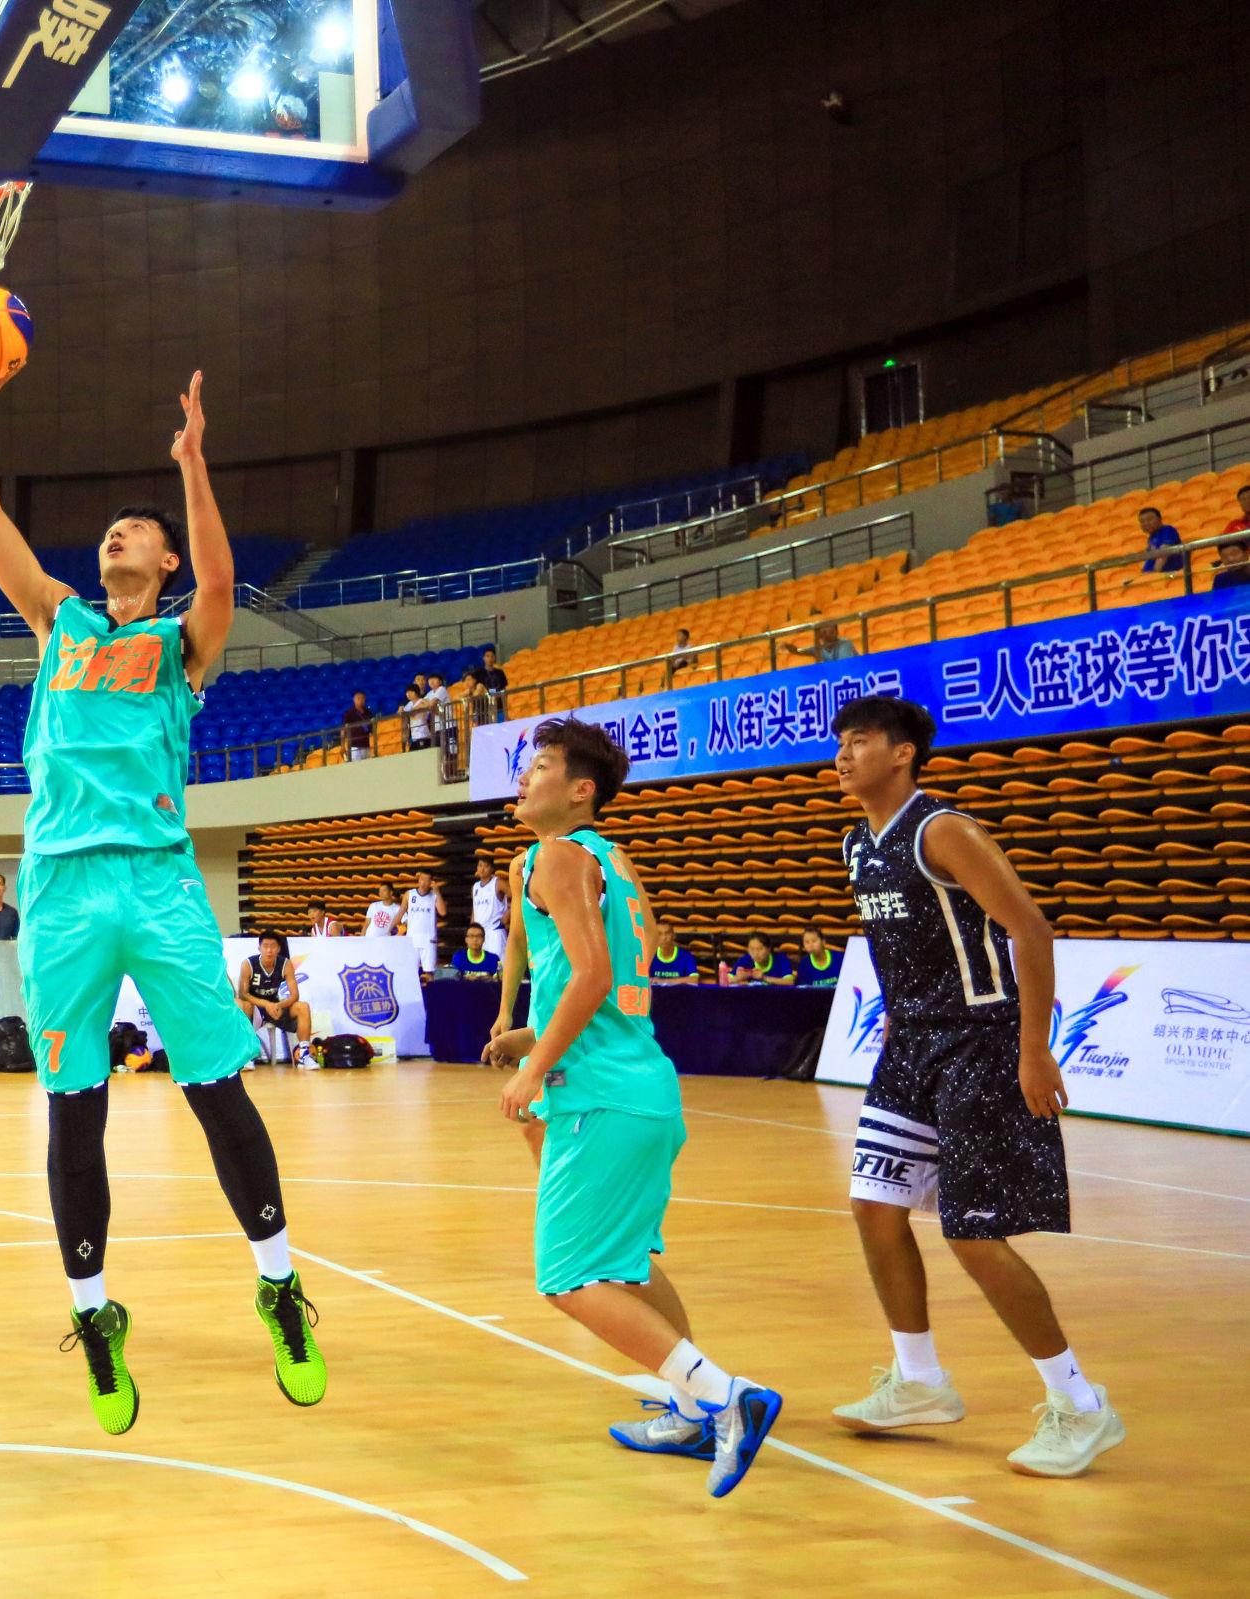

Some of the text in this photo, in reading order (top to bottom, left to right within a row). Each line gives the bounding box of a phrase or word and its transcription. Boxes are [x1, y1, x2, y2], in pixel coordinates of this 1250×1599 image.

[854, 889, 909, 920] 海大学生
[252, 973, 261, 986] 3
[42, 1030, 66, 1073] 7
[1078, 1045, 1130, 1068] Tianjin
[1166, 1044, 1232, 1061] OLYMPIC
[1164, 1057, 1232, 1071] SPORTS CENTER
